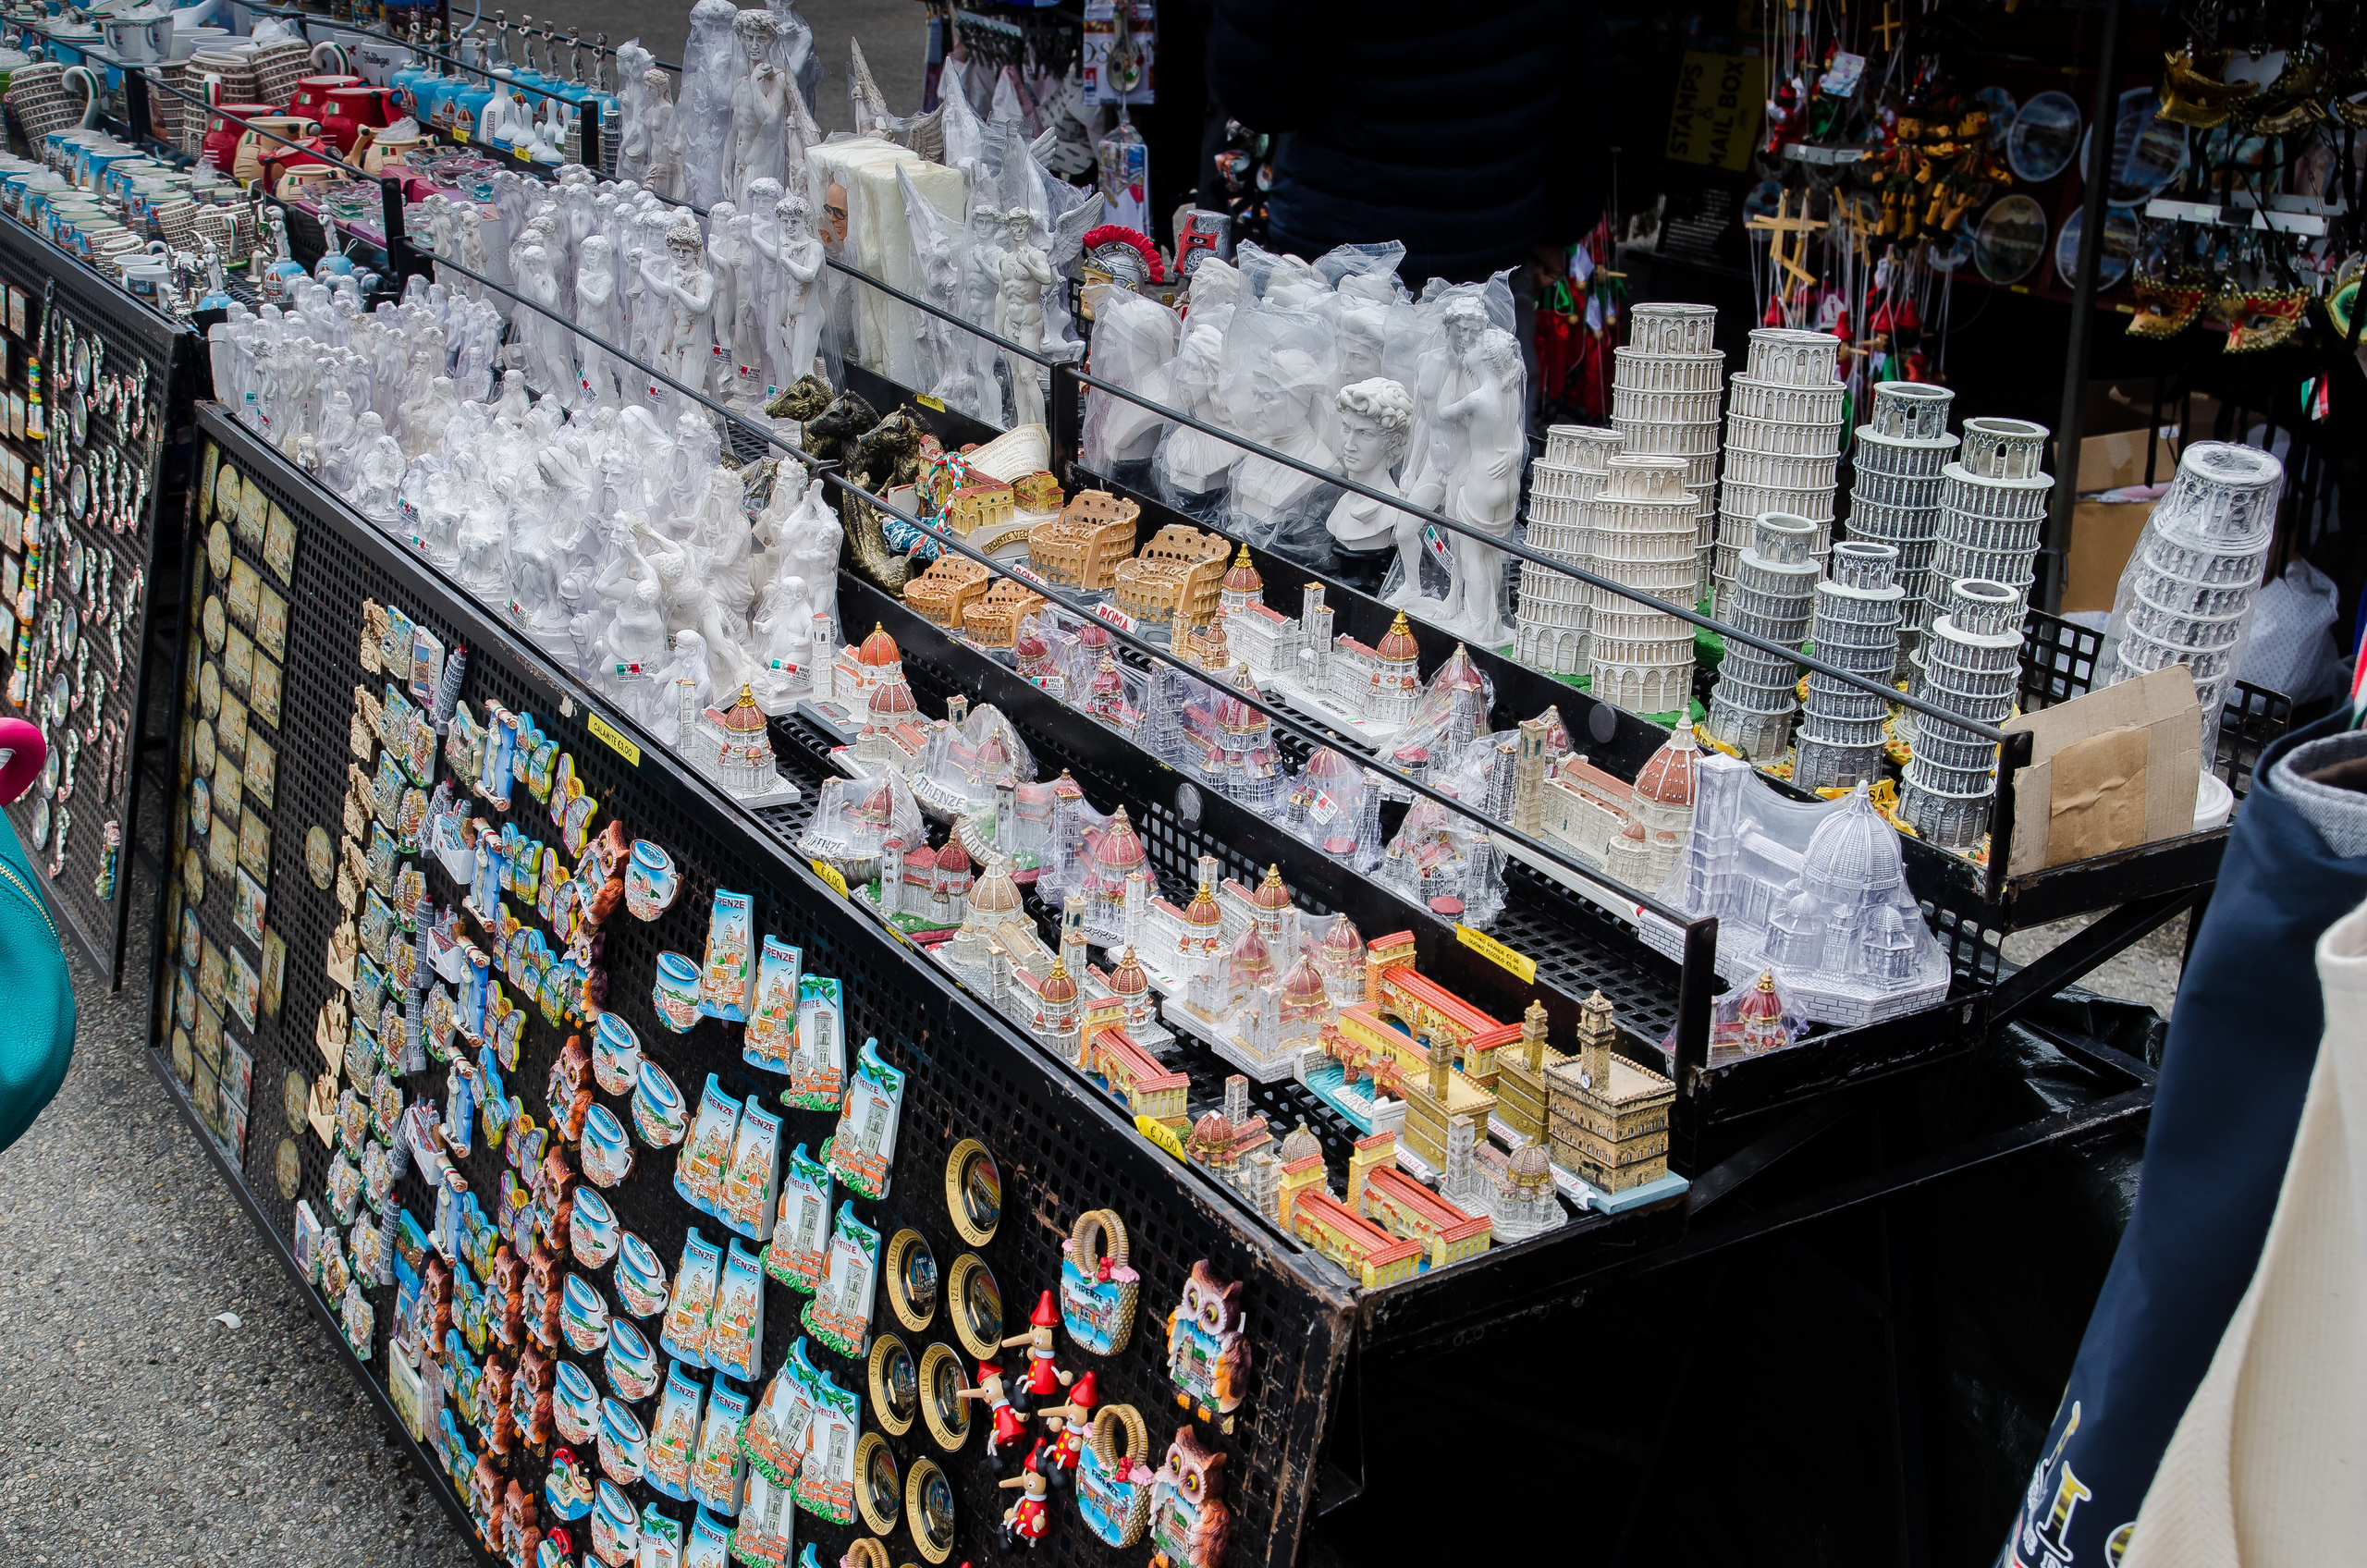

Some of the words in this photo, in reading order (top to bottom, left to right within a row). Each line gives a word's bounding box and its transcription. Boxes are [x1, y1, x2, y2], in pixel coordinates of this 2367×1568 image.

[1717, 60, 1747, 109] BOX
[1670, 64, 1703, 155] STAMPS
[1696, 105, 1713, 121] &
[1708, 115, 1734, 167] MAIL
[987, 533, 1012, 551] PONTE
[1099, 606, 1128, 631] ROMA
[594, 722, 617, 746] CALAMITE
[917, 775, 965, 810] FIRENZE
[962, 827, 993, 864] FIRENZ
[714, 894, 745, 910] FIRENZE
[763, 943, 795, 963] FIRENZE
[856, 1073, 878, 1095] FIRENZE
[705, 1089, 734, 1118] FIRENZE
[743, 1108, 776, 1133] FIRENZE
[1150, 1125, 1157, 1138] €
[1488, 1119, 1516, 1142] FIRENZE
[833, 1234, 857, 1255] FIRENZE
[963, 1225, 980, 1243] TALIA
[685, 1241, 716, 1263] FIRENZE
[729, 1252, 759, 1275] FIRENZE
[889, 1242, 899, 1271] ITALIA
[1074, 1281, 1103, 1304] FIRENZE
[872, 1343, 883, 1368] ITALIA
[967, 1339, 984, 1354] ITALI
[667, 1375, 697, 1400] FIRENZE
[712, 1388, 742, 1413] FIRENZE
[935, 1425, 952, 1445] FIREN
[912, 1466, 922, 1488] ITALIA
[1091, 1467, 1120, 1499] FIRENZE
[694, 1520, 725, 1545] FIRENZE
